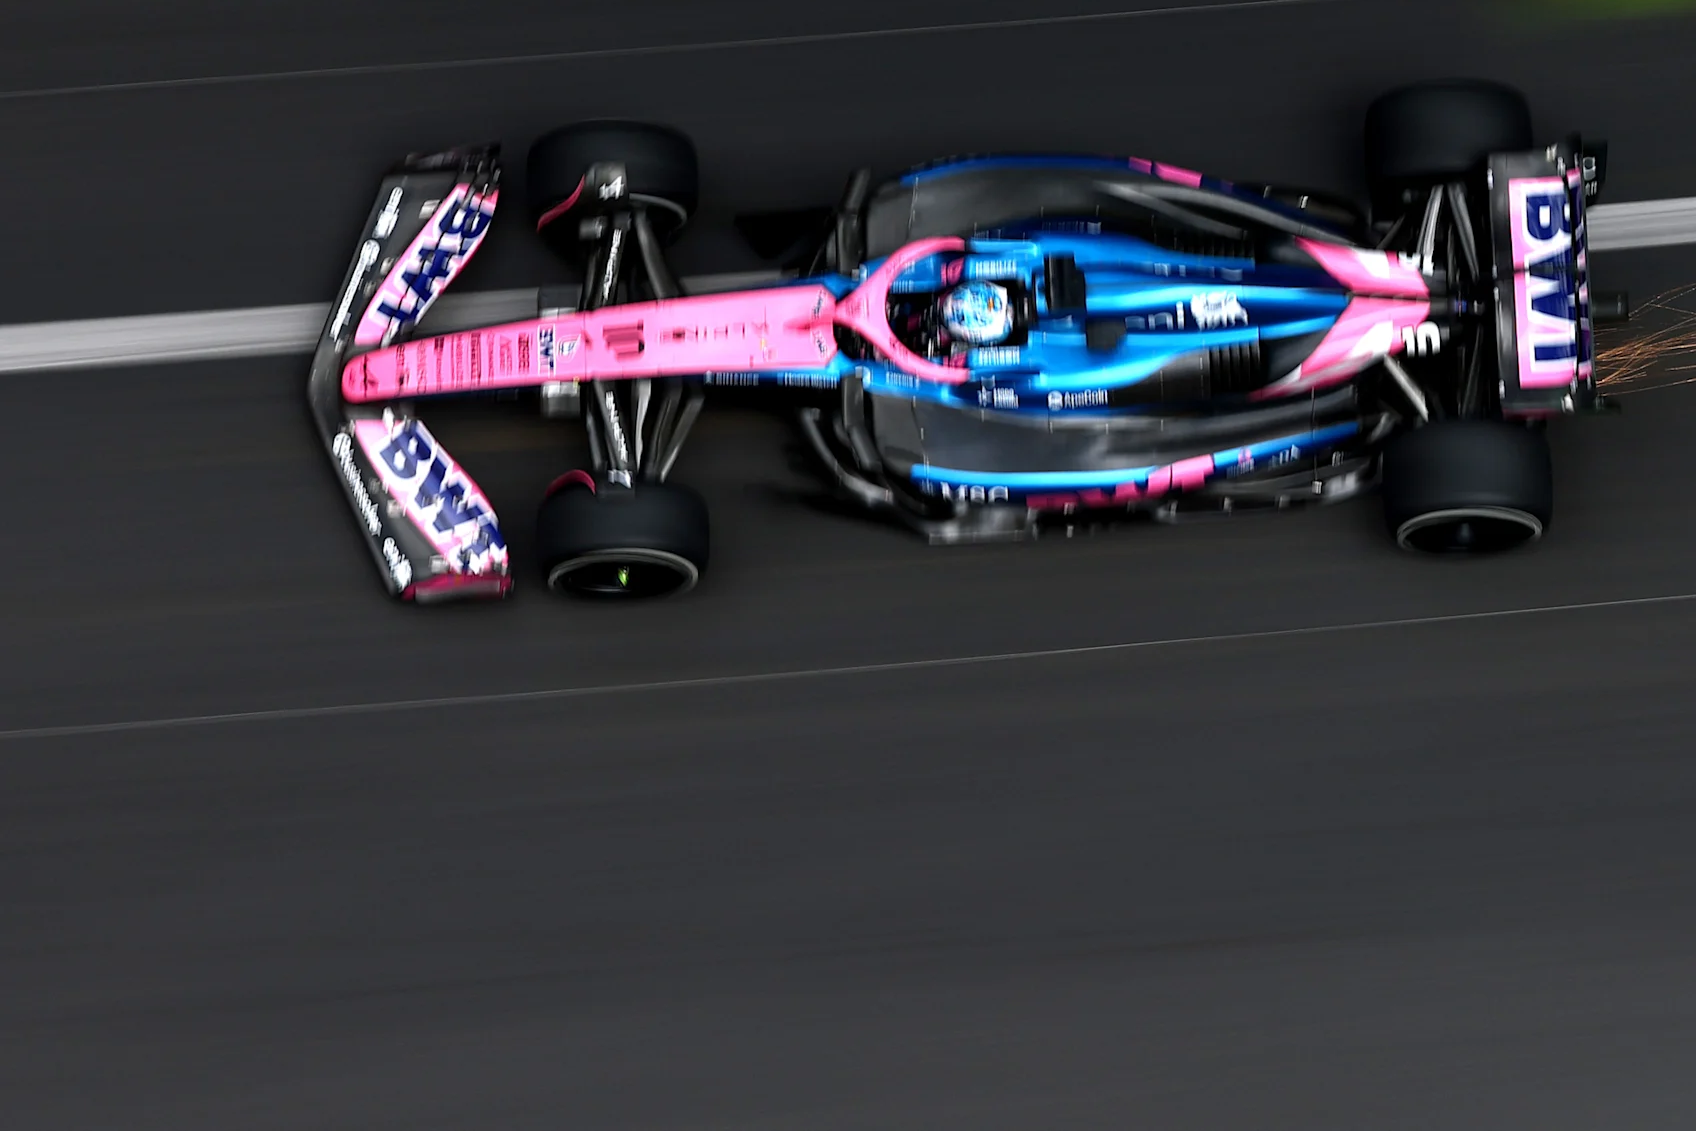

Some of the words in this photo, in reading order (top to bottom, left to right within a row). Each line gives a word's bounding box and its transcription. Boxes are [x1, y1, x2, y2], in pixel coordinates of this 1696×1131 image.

[376, 196, 494, 330] BWT
[1521, 182, 1591, 368] BWT
[379, 418, 506, 572] BWT
